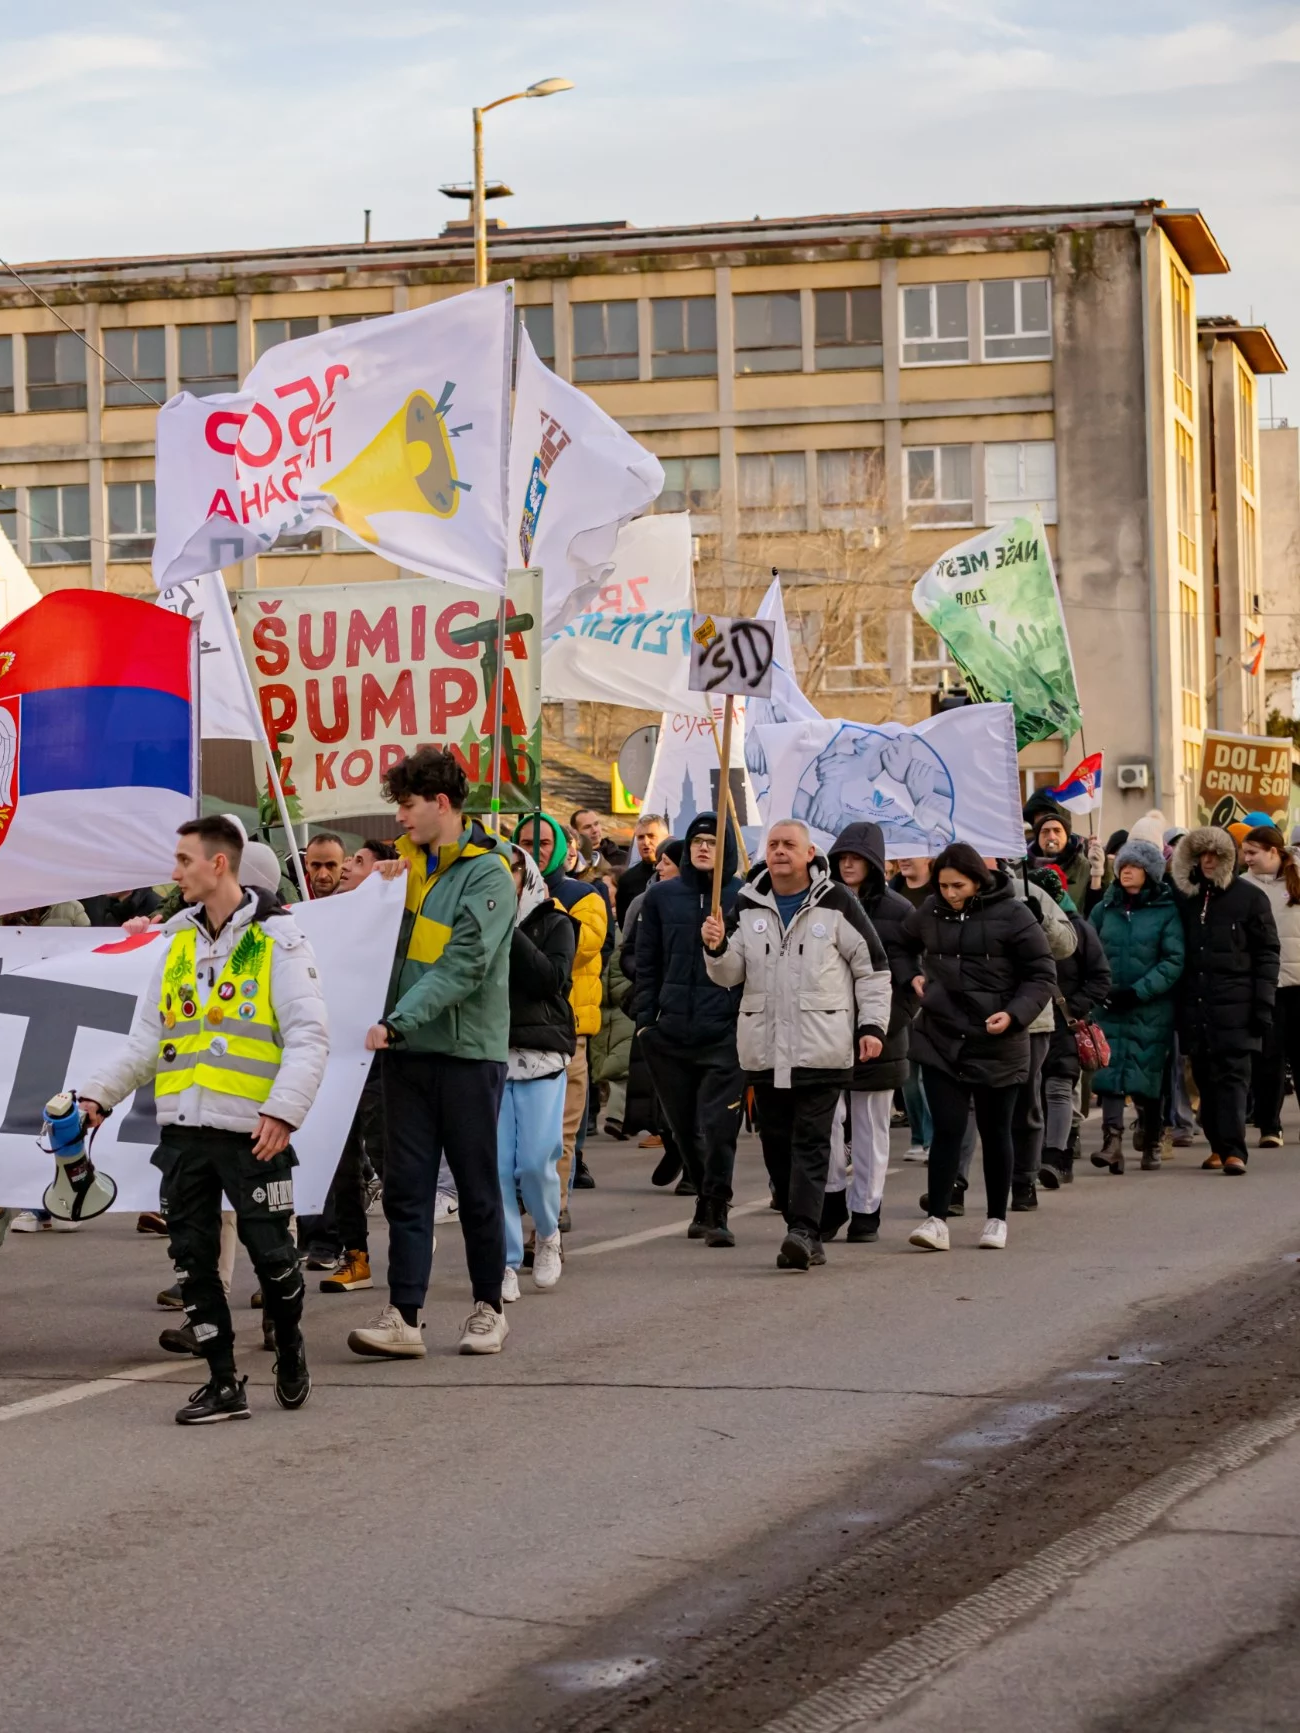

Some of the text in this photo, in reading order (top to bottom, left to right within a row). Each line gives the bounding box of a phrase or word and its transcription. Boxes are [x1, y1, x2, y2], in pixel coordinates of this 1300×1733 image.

[252, 599, 528, 677] ŠUMICA
[258, 667, 528, 744] PUMPA
[1205, 769, 1253, 794] CRNI
[1214, 744, 1288, 774] DOLJA
